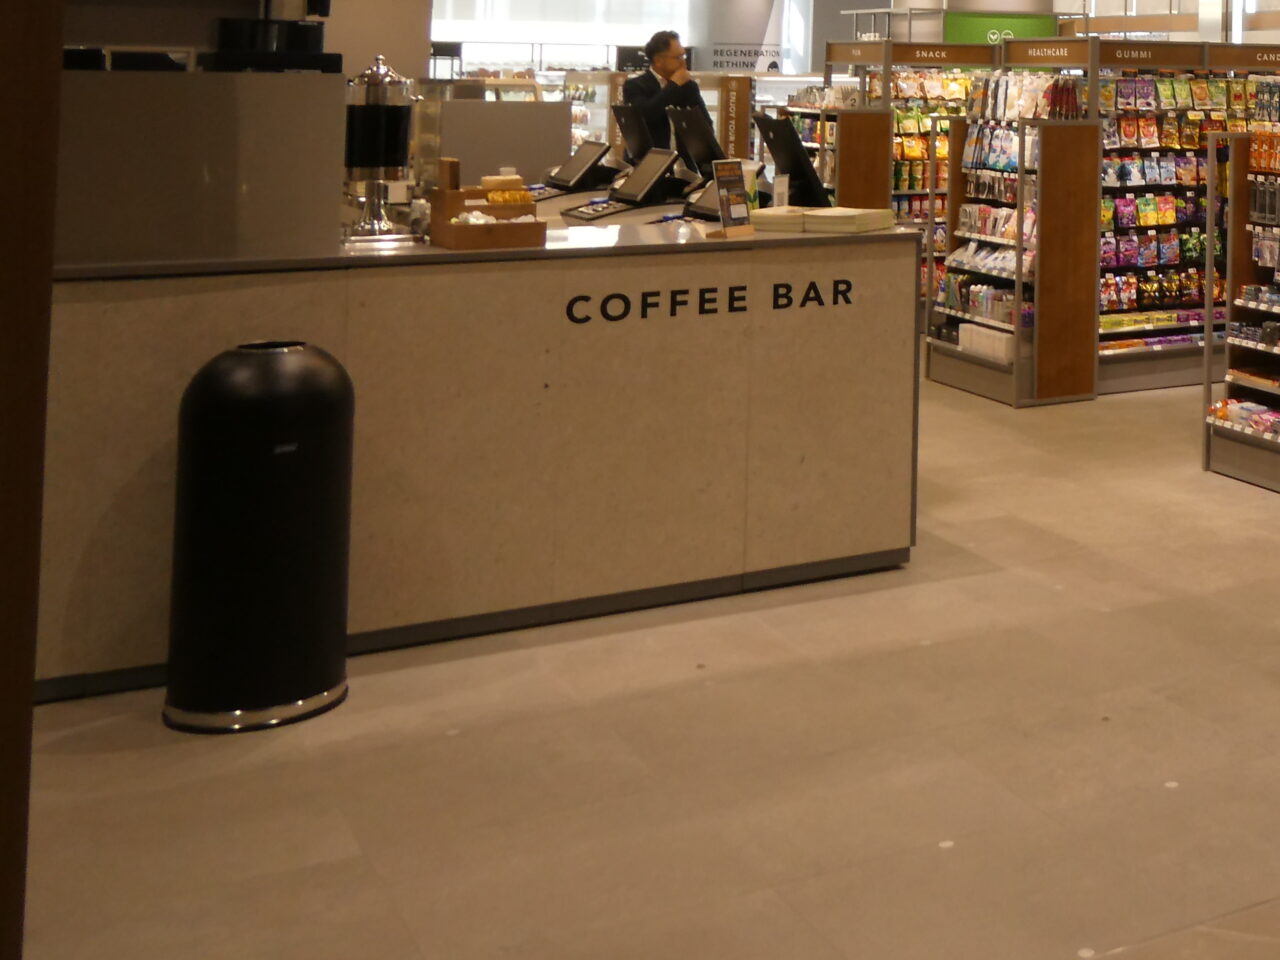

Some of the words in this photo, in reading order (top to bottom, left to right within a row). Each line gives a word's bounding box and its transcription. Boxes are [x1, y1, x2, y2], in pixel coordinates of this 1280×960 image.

[713, 48, 781, 58] REGENERATION
[915, 49, 948, 59] SNACK
[1028, 47, 1068, 57] HEALTHCARE
[1115, 49, 1152, 59] GUMMI
[712, 60, 757, 69] RETHINK
[565, 285, 748, 324] COFFEE
[772, 279, 853, 309] BAR
